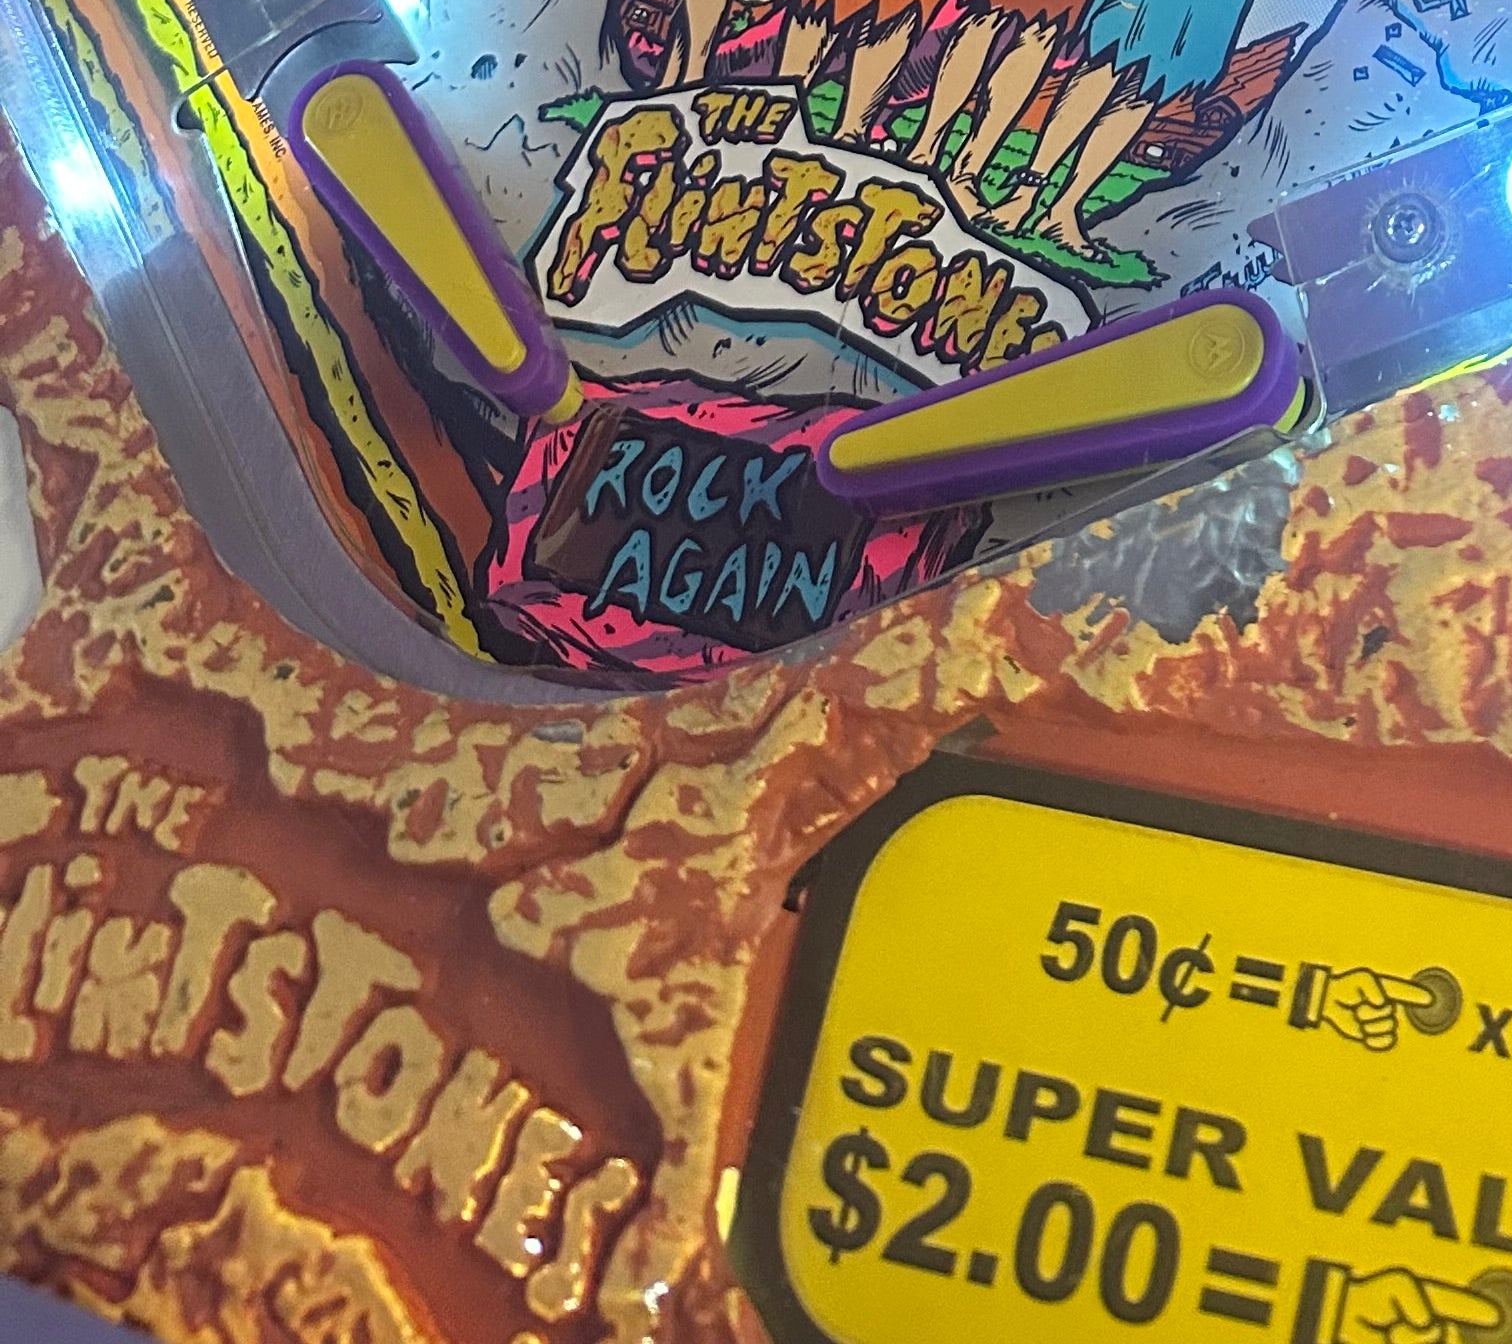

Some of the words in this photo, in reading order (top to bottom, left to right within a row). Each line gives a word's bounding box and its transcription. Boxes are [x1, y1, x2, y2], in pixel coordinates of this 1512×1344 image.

[691, 90, 798, 146] THE
[585, 438, 807, 526] ROCK
[589, 528, 838, 623] AGAIN
[73, 756, 207, 852] THE
[839, 1033, 1248, 1192] SUPER
